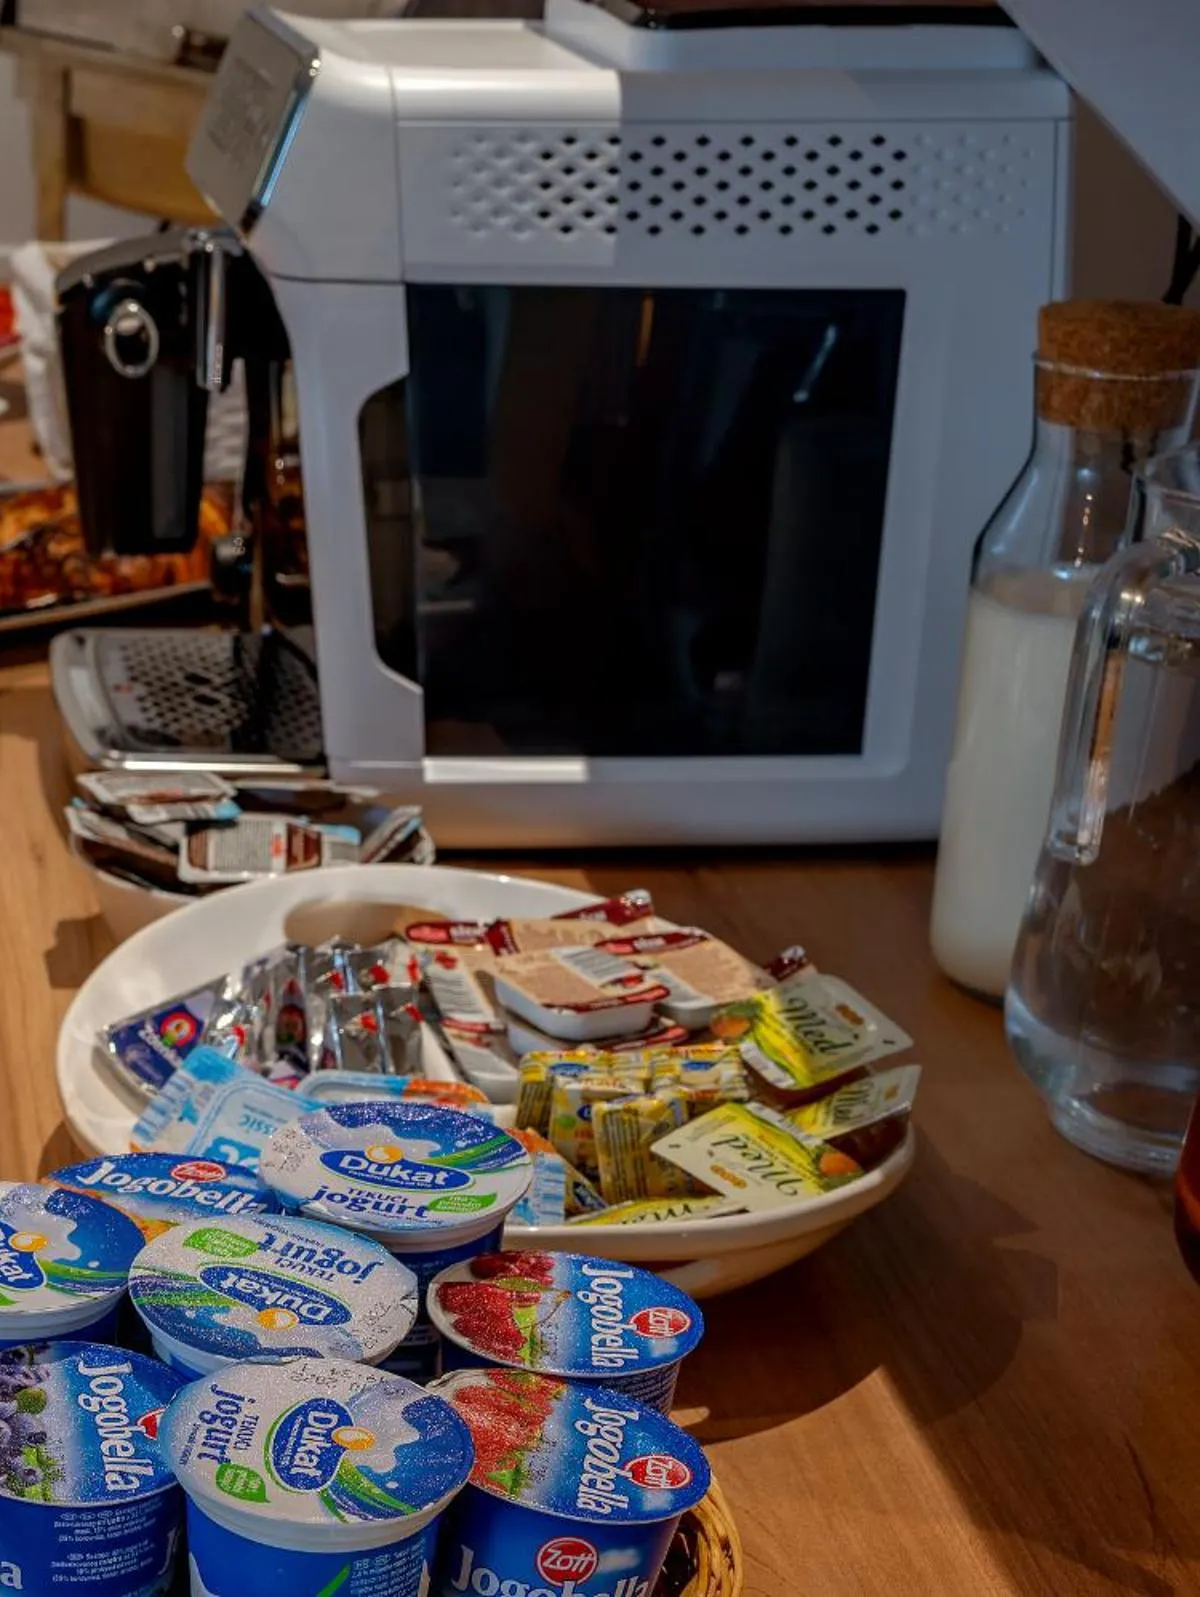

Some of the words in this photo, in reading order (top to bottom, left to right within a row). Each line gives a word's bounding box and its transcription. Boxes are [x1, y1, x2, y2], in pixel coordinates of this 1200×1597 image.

[786, 997, 854, 1054] Med
[76, 1161, 268, 1214] Jogobella
[339, 1155, 453, 1186] Dukat
[712, 1134, 804, 1196] Med
[310, 1185, 432, 1219] jogurt
[259, 1232, 384, 1284] jogurt
[219, 1272, 334, 1322] Dukat
[577, 1263, 640, 1367] Jogobella
[648, 1310, 675, 1337] Zott
[78, 1356, 154, 1491] Jogobella
[197, 1384, 256, 1464] jogurt
[289, 1410, 340, 1478] Dukat
[574, 1398, 640, 1514] Jogobella
[644, 1458, 674, 1488] Zott
[451, 1544, 649, 1597] Jogoblla
[542, 1547, 596, 1573] Zott
